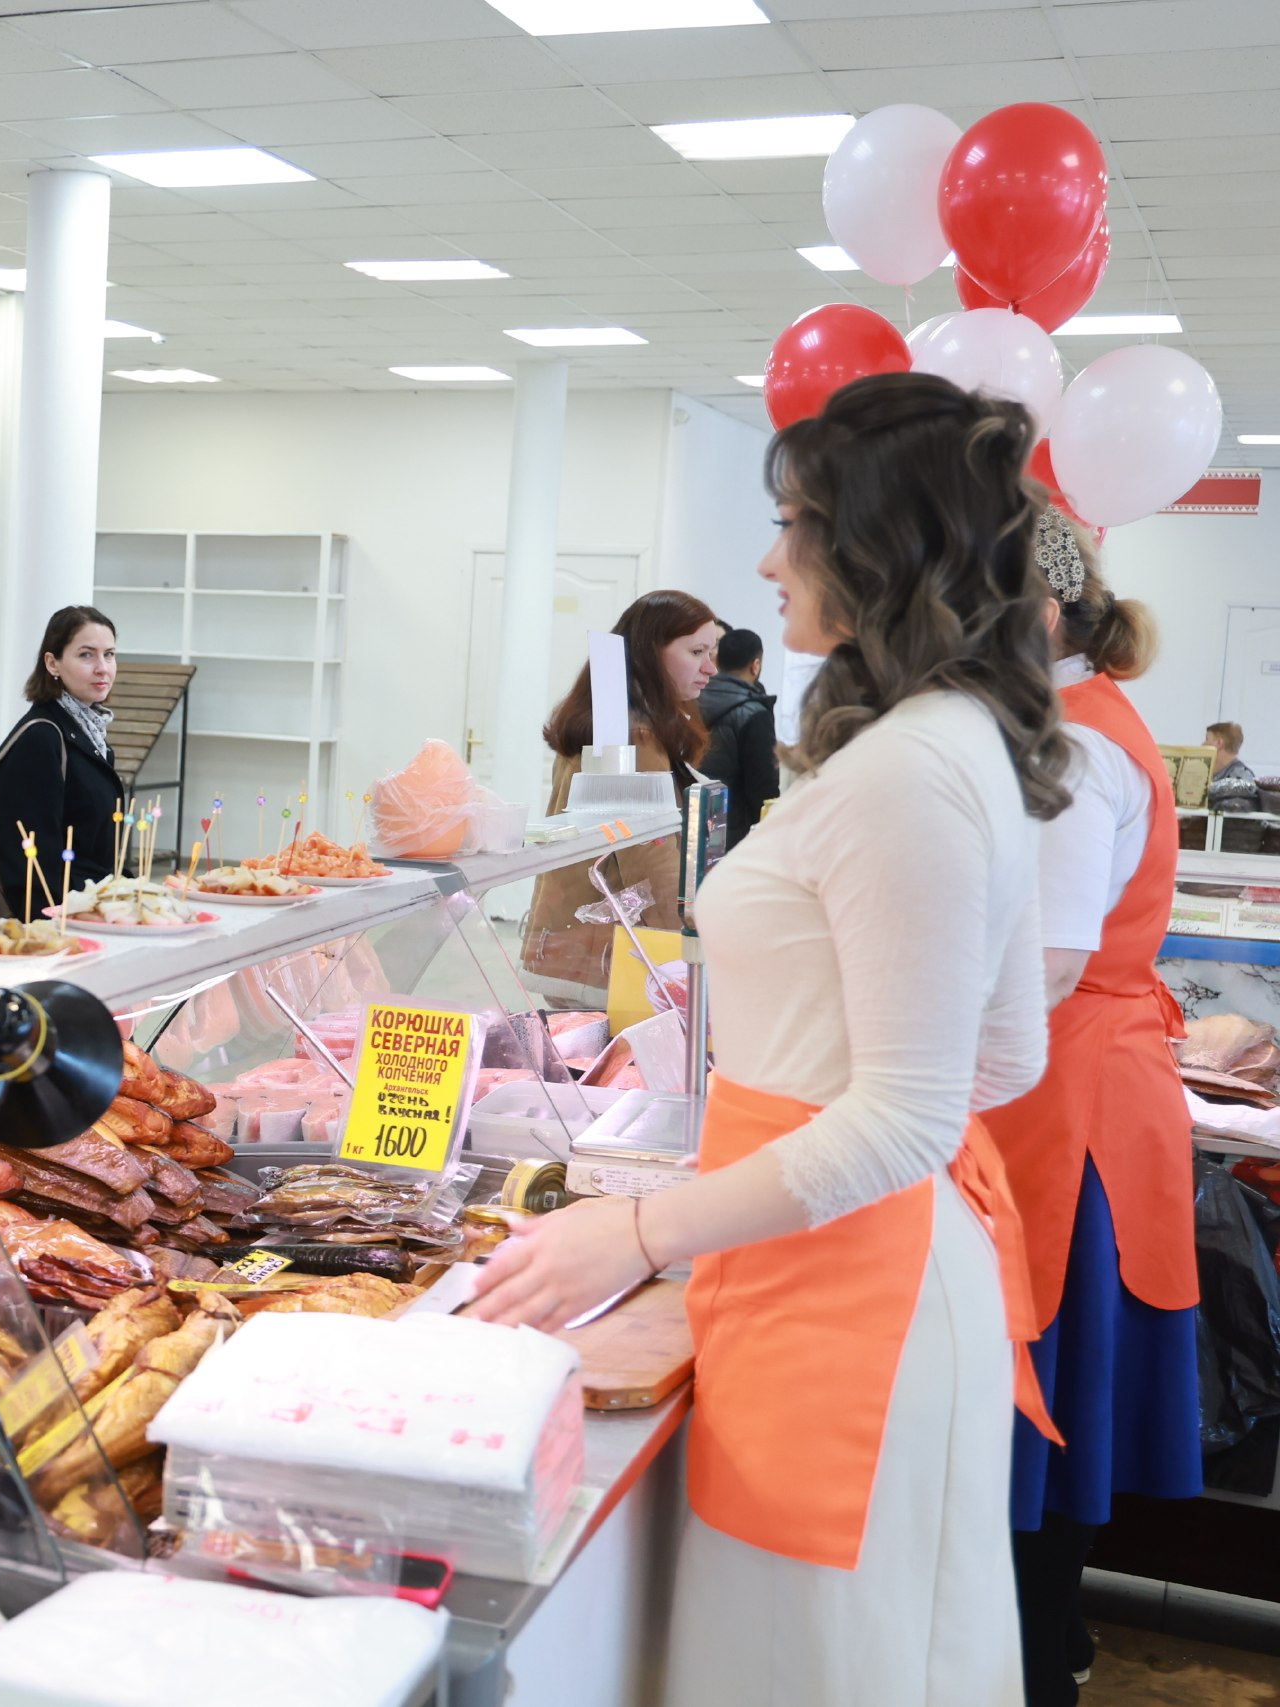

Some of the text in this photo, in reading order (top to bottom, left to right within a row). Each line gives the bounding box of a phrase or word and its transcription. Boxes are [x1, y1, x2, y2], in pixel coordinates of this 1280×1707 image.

[371, 1009, 464, 1037] КОРЮШКА
[371, 1031, 460, 1058] СЕВЕРНАЯ
[376, 1053, 448, 1073] ХОЛОДНОГО
[377, 1066, 442, 1085] КОПЧЕНИЯ
[346, 1143, 365, 1155] 1 кг
[375, 1124, 427, 1158] 1600
